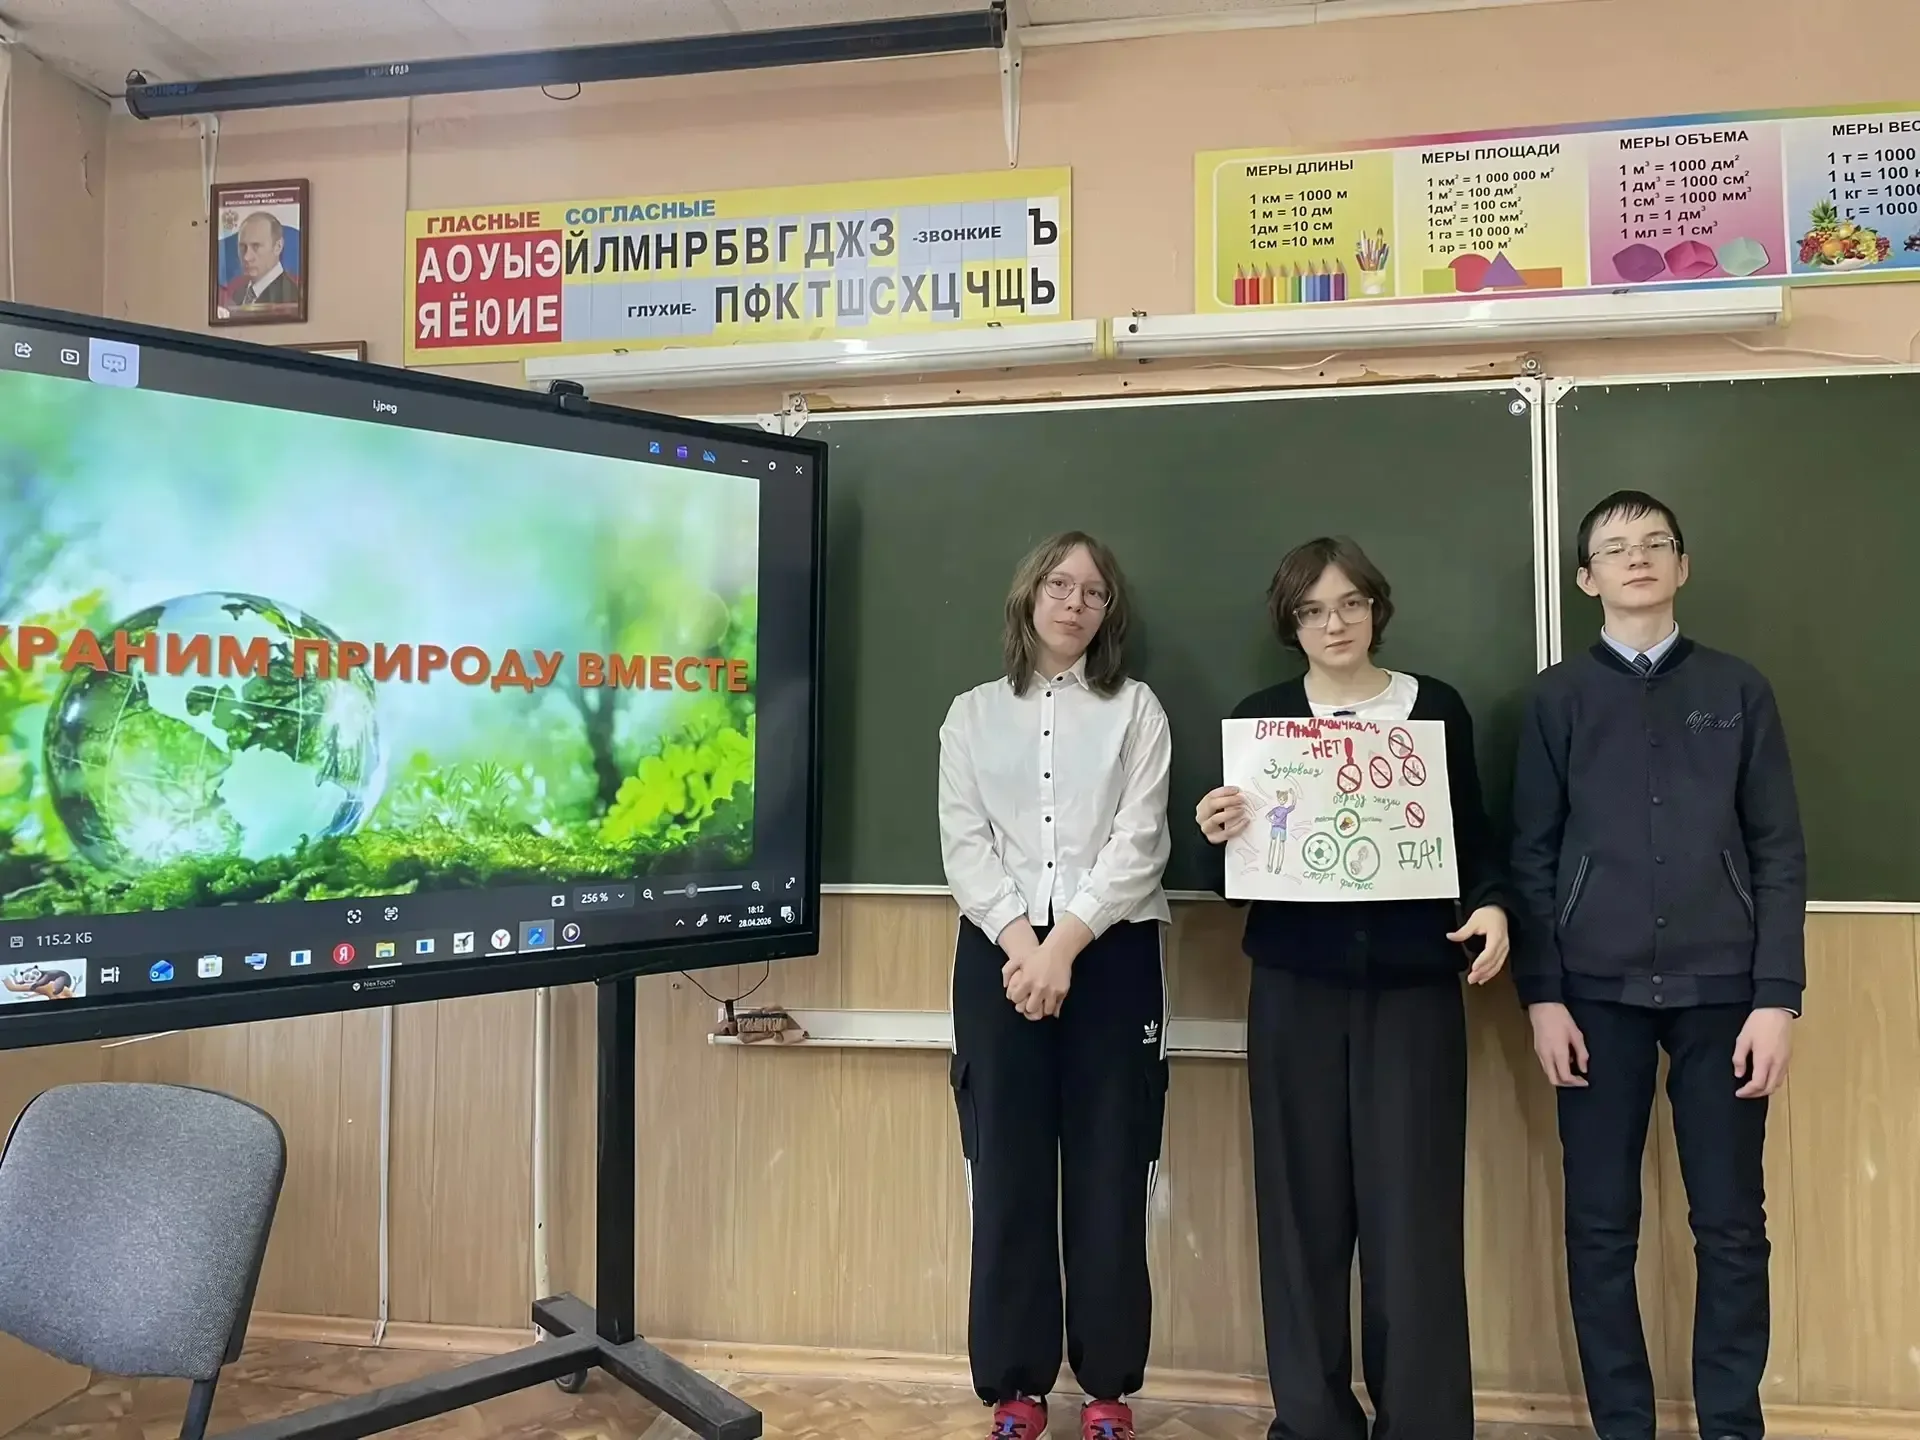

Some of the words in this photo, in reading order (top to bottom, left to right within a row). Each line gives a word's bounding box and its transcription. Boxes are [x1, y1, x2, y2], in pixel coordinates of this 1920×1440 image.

[1832, 122, 1883, 136] МЕРЫ
[1619, 136, 1670, 150] МЕРЫ
[1675, 130, 1749, 146] ОБЪЕМА
[1421, 150, 1470, 165] МЕРЫ
[1475, 143, 1560, 160] ПЛОЩАДИ
[1827, 152, 1835, 165] 1
[1842, 154, 1852, 164] т
[1874, 148, 1916, 162] 1000
[1246, 164, 1292, 177] МЕРЫ
[1296, 160, 1354, 175] ДЛИНЫ
[1619, 165, 1627, 176] 1
[1670, 159, 1706, 172] 1000
[1828, 170, 1836, 182] 1
[1844, 172, 1855, 183] ц
[1877, 166, 1909, 180] 100
[1427, 178, 1433, 187] 1
[1475, 174, 1481, 184] 1
[1486, 172, 1509, 183] 000
[1513, 170, 1536, 181] 000
[1619, 181, 1627, 192] 1
[1665, 179, 1675, 187] =
[1681, 175, 1718, 188] 1000
[1250, 194, 1256, 204] 1
[1262, 194, 1281, 204] км
[1298, 189, 1332, 201] 1000
[1337, 190, 1348, 199] м
[1427, 191, 1433, 200] 1
[1468, 187, 1491, 198] 100
[1619, 197, 1627, 208] 1
[1665, 195, 1674, 203] =
[1680, 191, 1717, 204] 1000
[1829, 188, 1837, 200] 1
[1845, 189, 1862, 200] кг
[565, 199, 716, 225] СОГЛАСНЫЕ
[1250, 209, 1256, 219] 1
[1262, 210, 1273, 219] м
[1291, 206, 1307, 217] 10
[1311, 206, 1333, 218] дм
[1473, 200, 1496, 211] 100
[1830, 206, 1838, 218] 1
[1846, 208, 1854, 218] г
[1876, 201, 1918, 216] 1000
[427, 211, 540, 234] ГЛАСНЫЕ
[1472, 213, 1495, 224] 100
[1620, 213, 1627, 224] 1
[1633, 213, 1644, 223] л
[1664, 210, 1672, 221] 1
[912, 225, 1001, 244] -ЗВОНКИЕ
[1028, 207, 1058, 246] Ъ
[1313, 221, 1333, 231] см
[1428, 231, 1433, 240] 1
[1439, 231, 1452, 240] га
[1468, 227, 1483, 238] 10
[1487, 225, 1510, 236] 000
[1620, 228, 1628, 239] 1
[1634, 228, 1657, 239] мл
[1677, 225, 1685, 236] 1
[1312, 236, 1335, 246] мм
[1428, 244, 1434, 253] 1
[1439, 244, 1455, 255] ар
[1471, 240, 1494, 251] 100
[418, 292, 558, 339] ЯЁЮИЕ
[627, 303, 697, 318] ГЛУХИЕ-
[0, 624, 271, 678] РАНИМ
[293, 638, 564, 693] ПРИРОДУ
[577, 651, 749, 693] ВМЕСТЕ
[581, 893, 598, 904] 256
[599, 892, 609, 901] %
[747, 905, 764, 914] 18:12
[718, 914, 732, 923] РУС
[738, 917, 772, 928] 28.04.2026
[36, 933, 71, 948] 115.2
[75, 932, 93, 945] КБ
